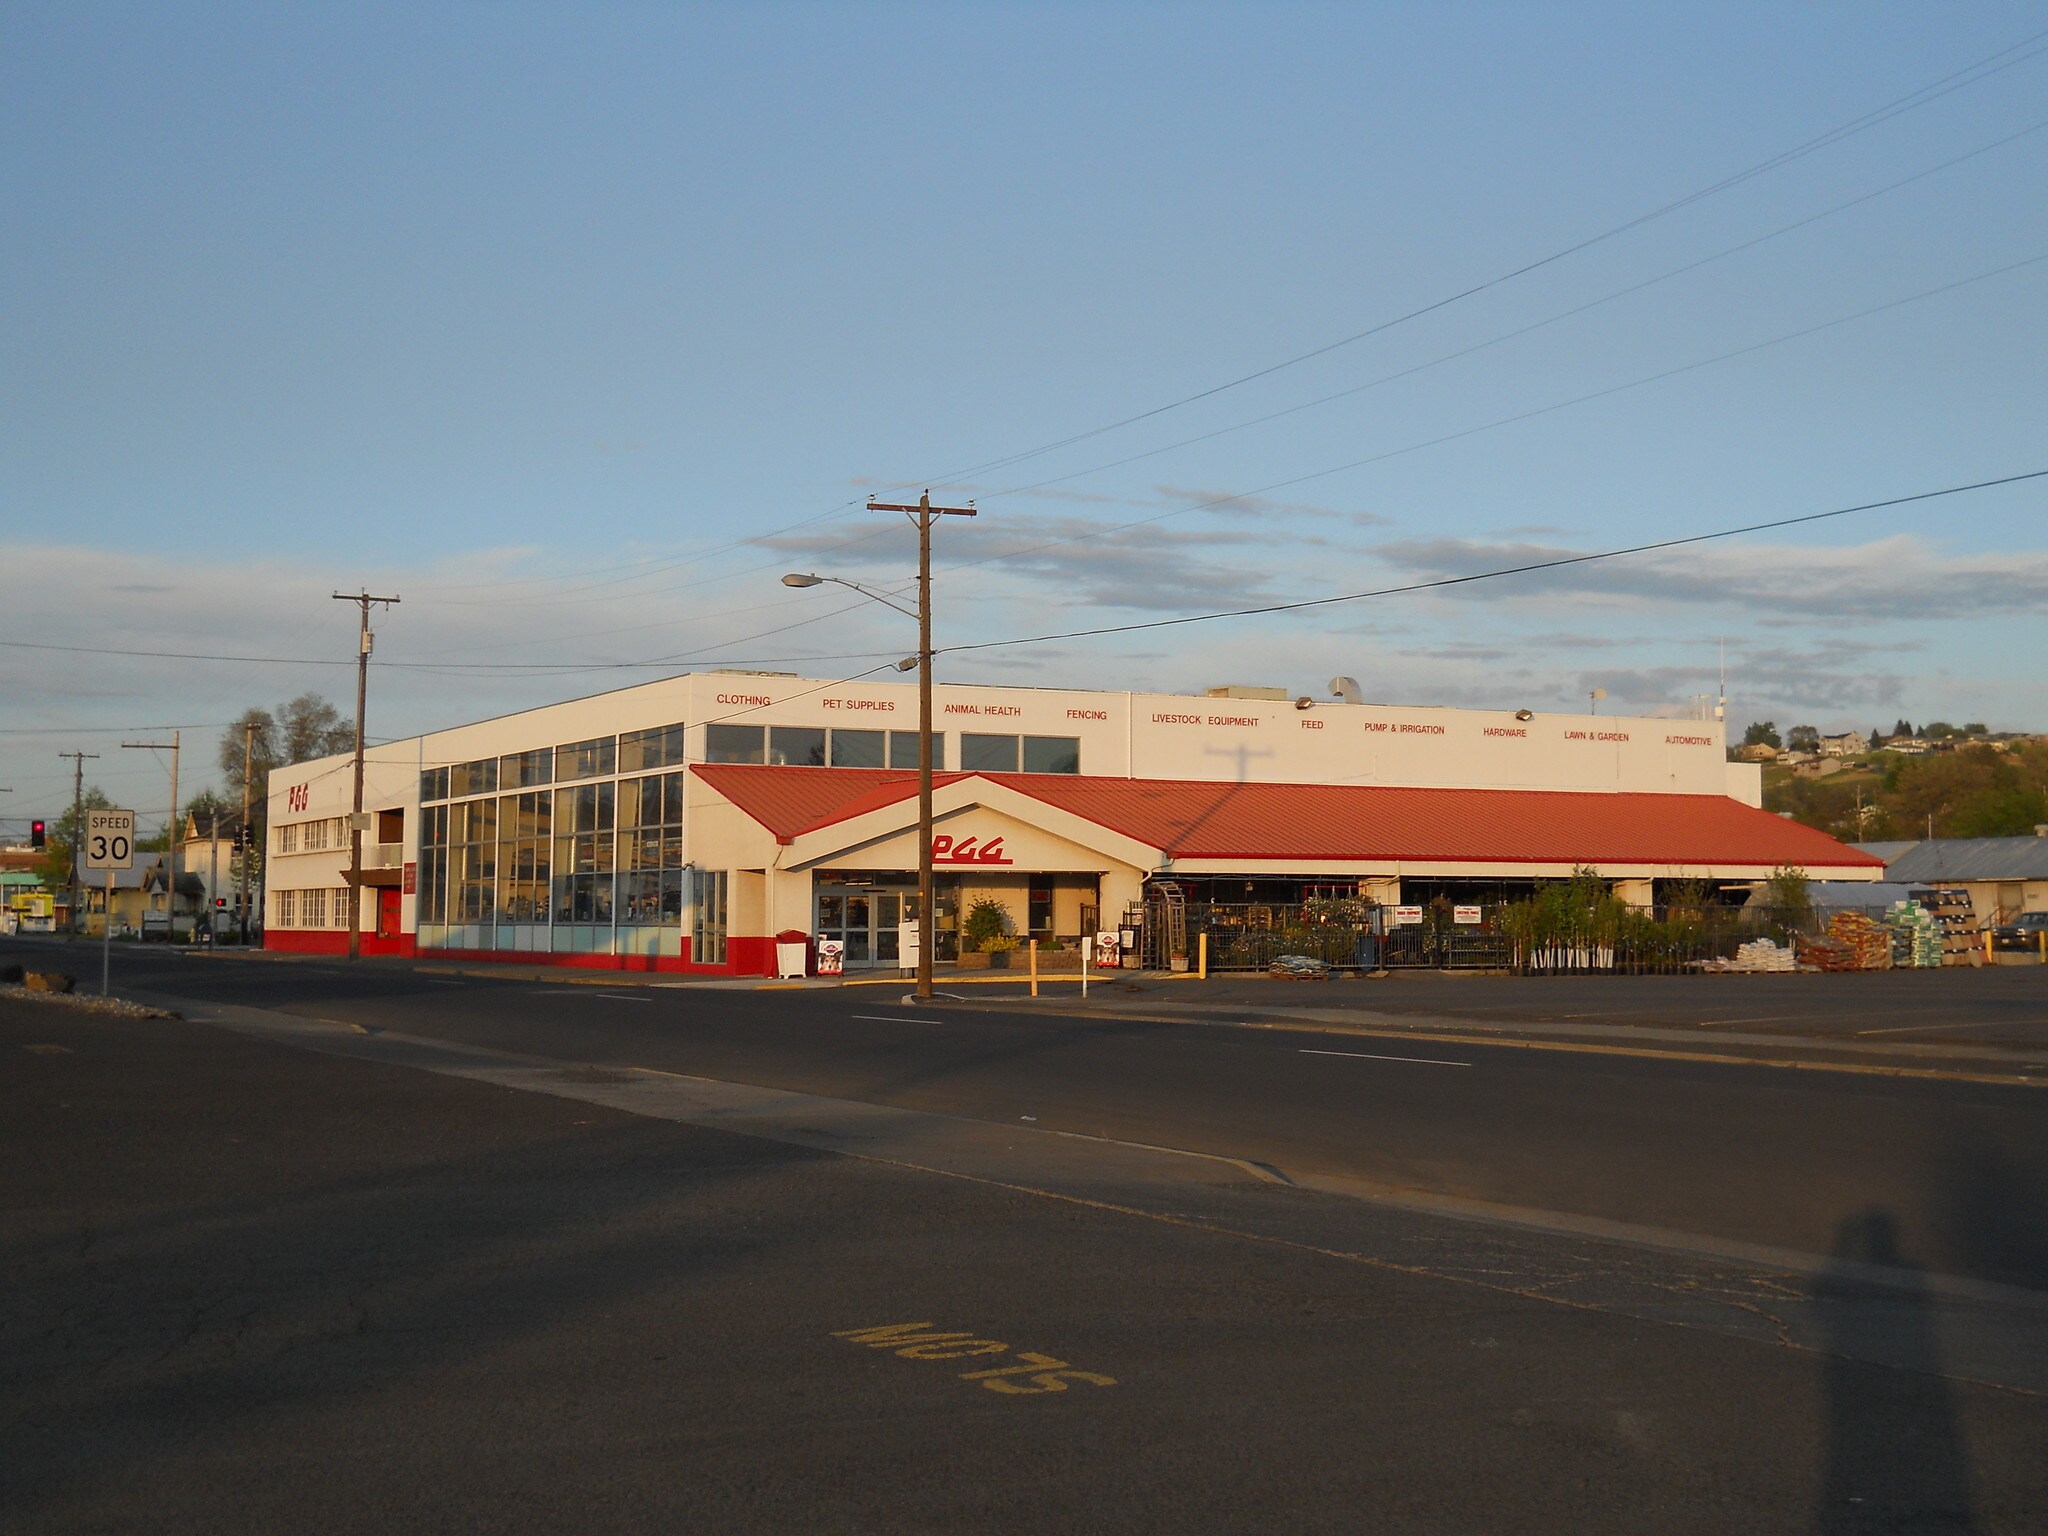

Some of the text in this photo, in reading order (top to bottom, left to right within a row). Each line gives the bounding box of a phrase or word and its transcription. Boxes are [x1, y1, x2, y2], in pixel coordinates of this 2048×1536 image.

[717, 694, 772, 706] CLOTHING
[822, 699, 895, 712] PET SUPPLIES
[944, 704, 1021, 716] ANIMAL HEALTH
[1066, 709, 1107, 720] FENCING
[1152, 713, 1259, 727] LIVESTOCK EQUIPMENT
[1301, 719, 1324, 730] FEED
[1364, 722, 1445, 735] PUMP & IRRIGATION
[1483, 727, 1527, 738] HARDWARE
[1564, 731, 1630, 742] LAWN & GARDEN
[1665, 736, 1712, 746] AUTOMOTIVE
[92, 816, 130, 828] SPEED
[90, 836, 129, 861] 30
[829, 1321, 1118, 1394] SLOW
